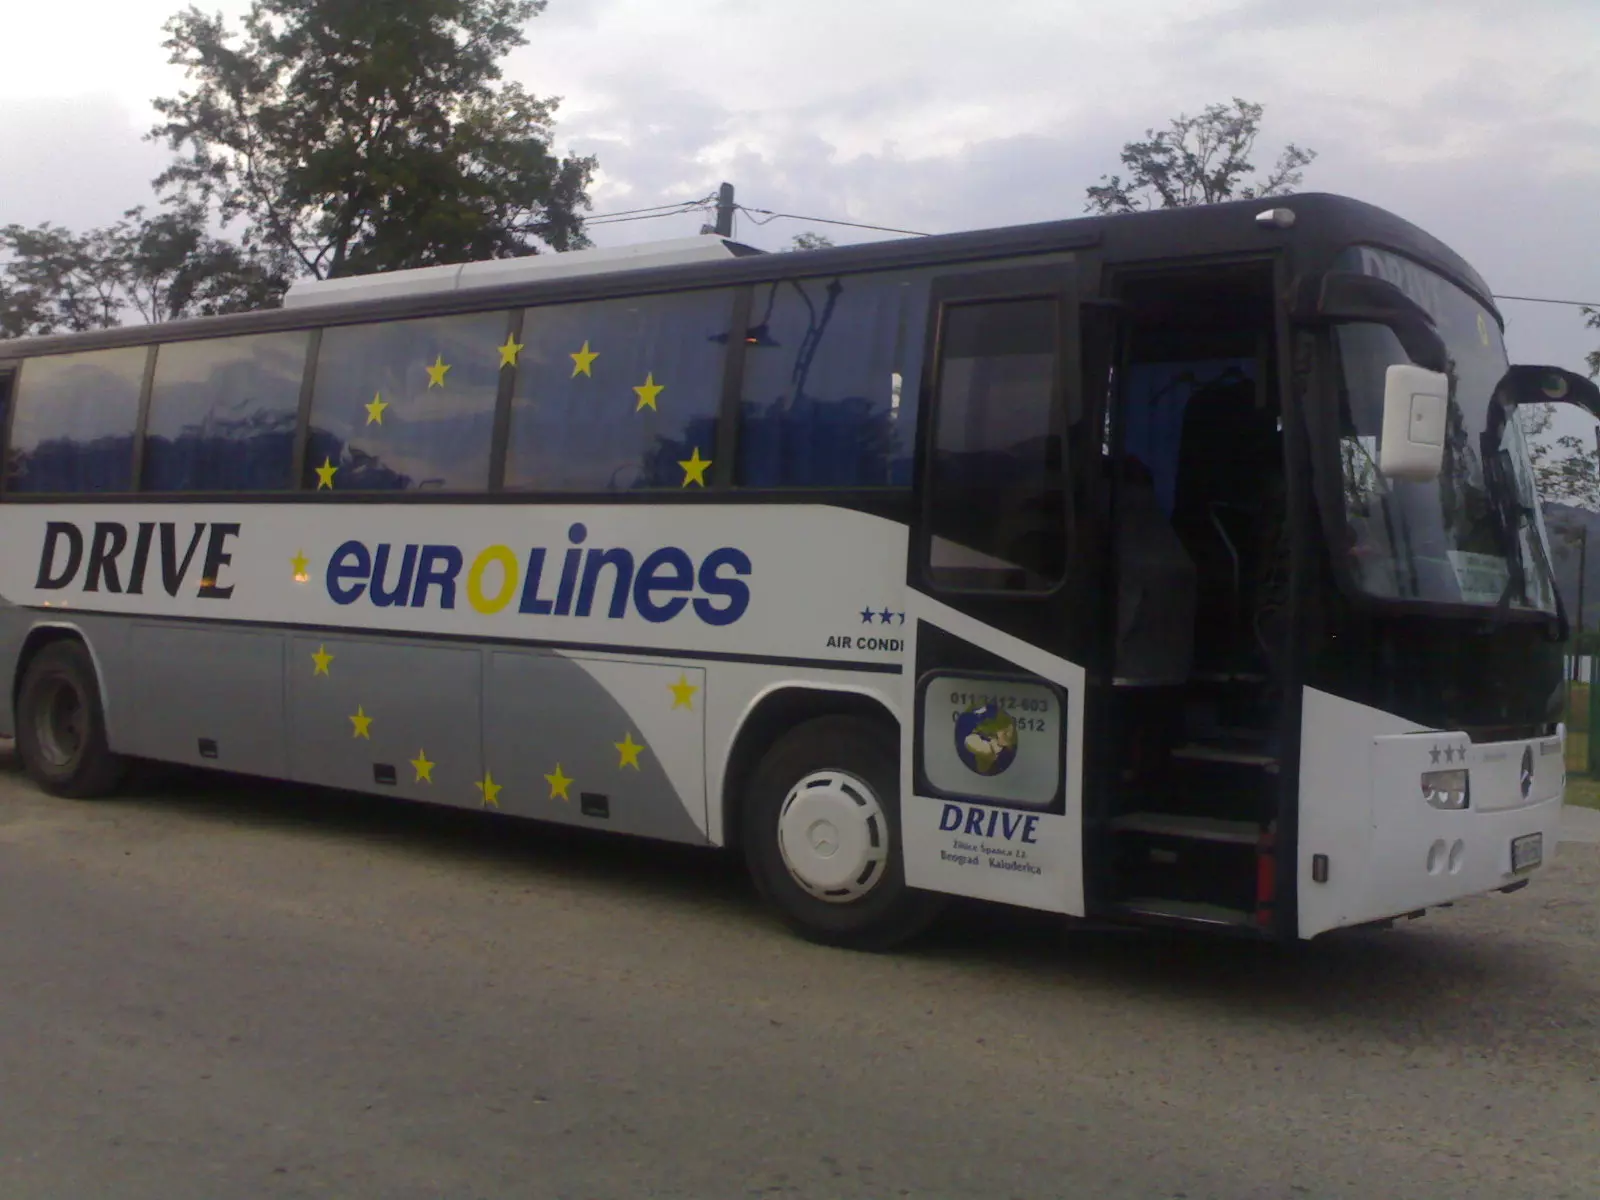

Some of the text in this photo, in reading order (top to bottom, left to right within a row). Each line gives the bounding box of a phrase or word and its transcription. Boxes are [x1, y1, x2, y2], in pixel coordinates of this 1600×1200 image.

[35, 521, 241, 600] DRIVE
[827, 635, 852, 649] AIR
[939, 803, 1040, 844] DRIVE
